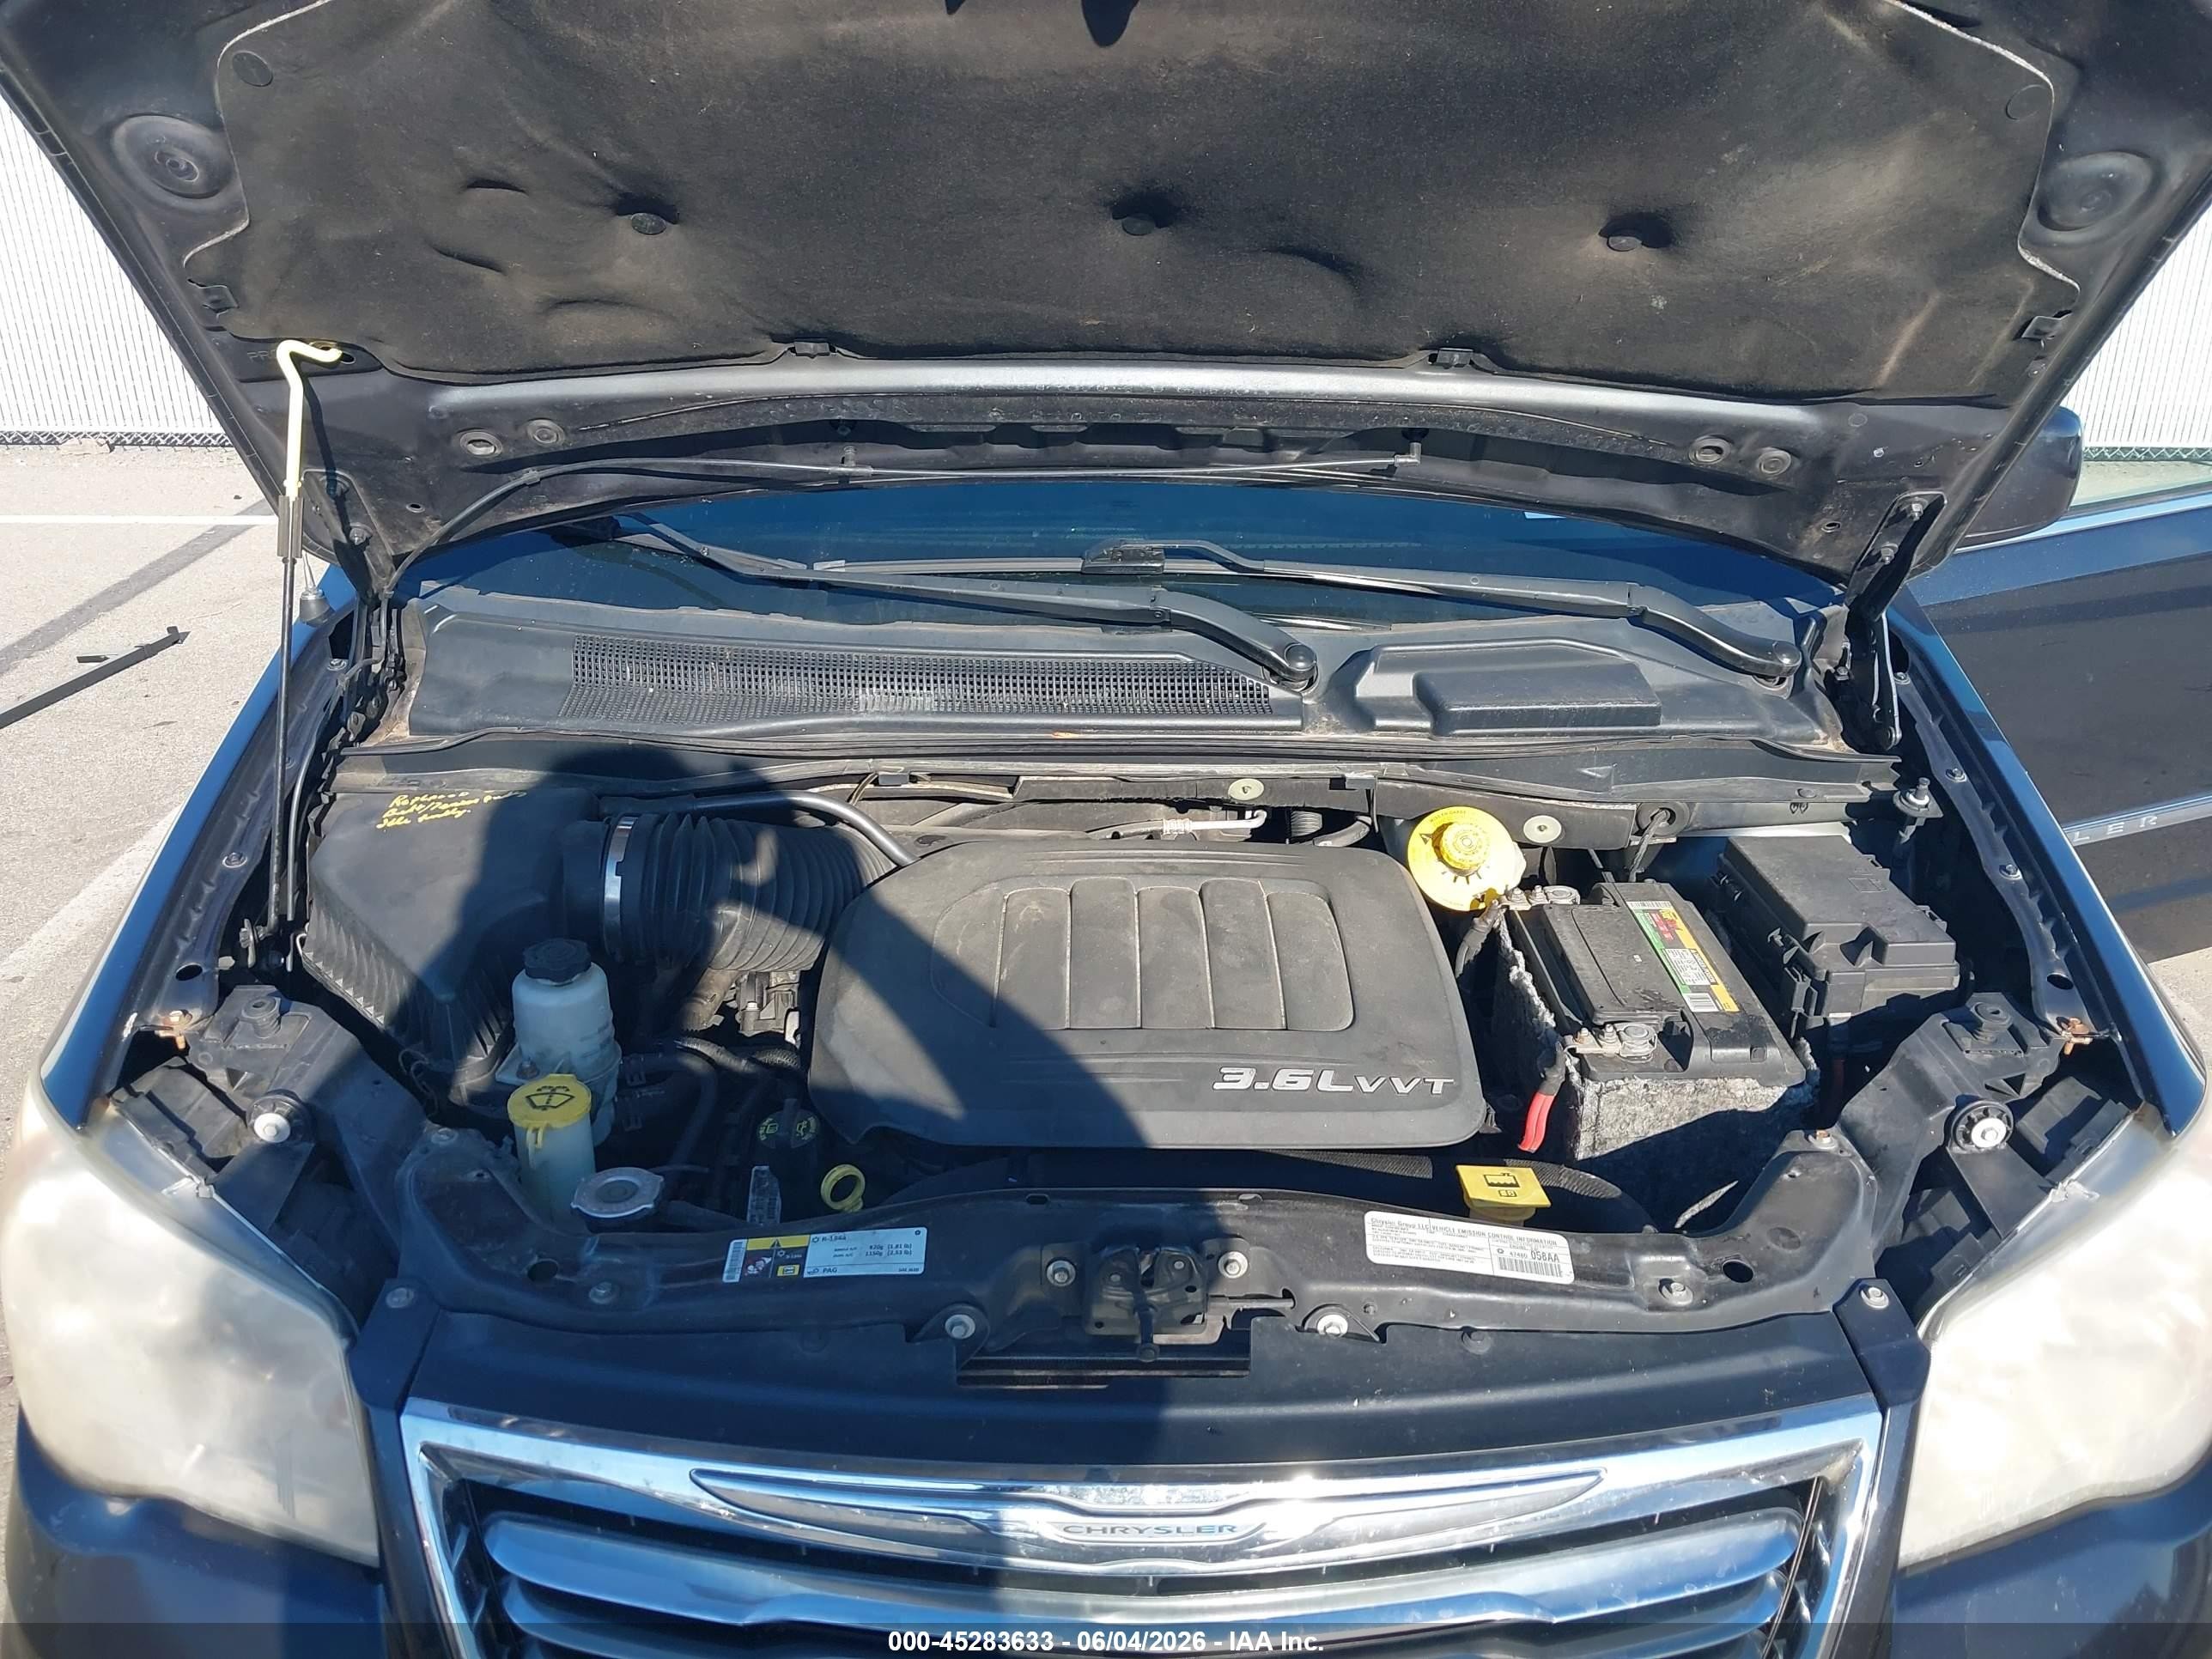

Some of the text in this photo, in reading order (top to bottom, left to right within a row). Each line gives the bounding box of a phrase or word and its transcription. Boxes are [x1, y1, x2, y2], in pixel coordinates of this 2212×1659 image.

[1431, 1224, 1455, 1233] VEHICLE
[1457, 1228, 1486, 1237] EMISSION
[1516, 1236, 1557, 1246] INFORMATION
[1530, 1250, 1560, 1263] 058AA
[1063, 1524, 1237, 1534] CHRYSLER
